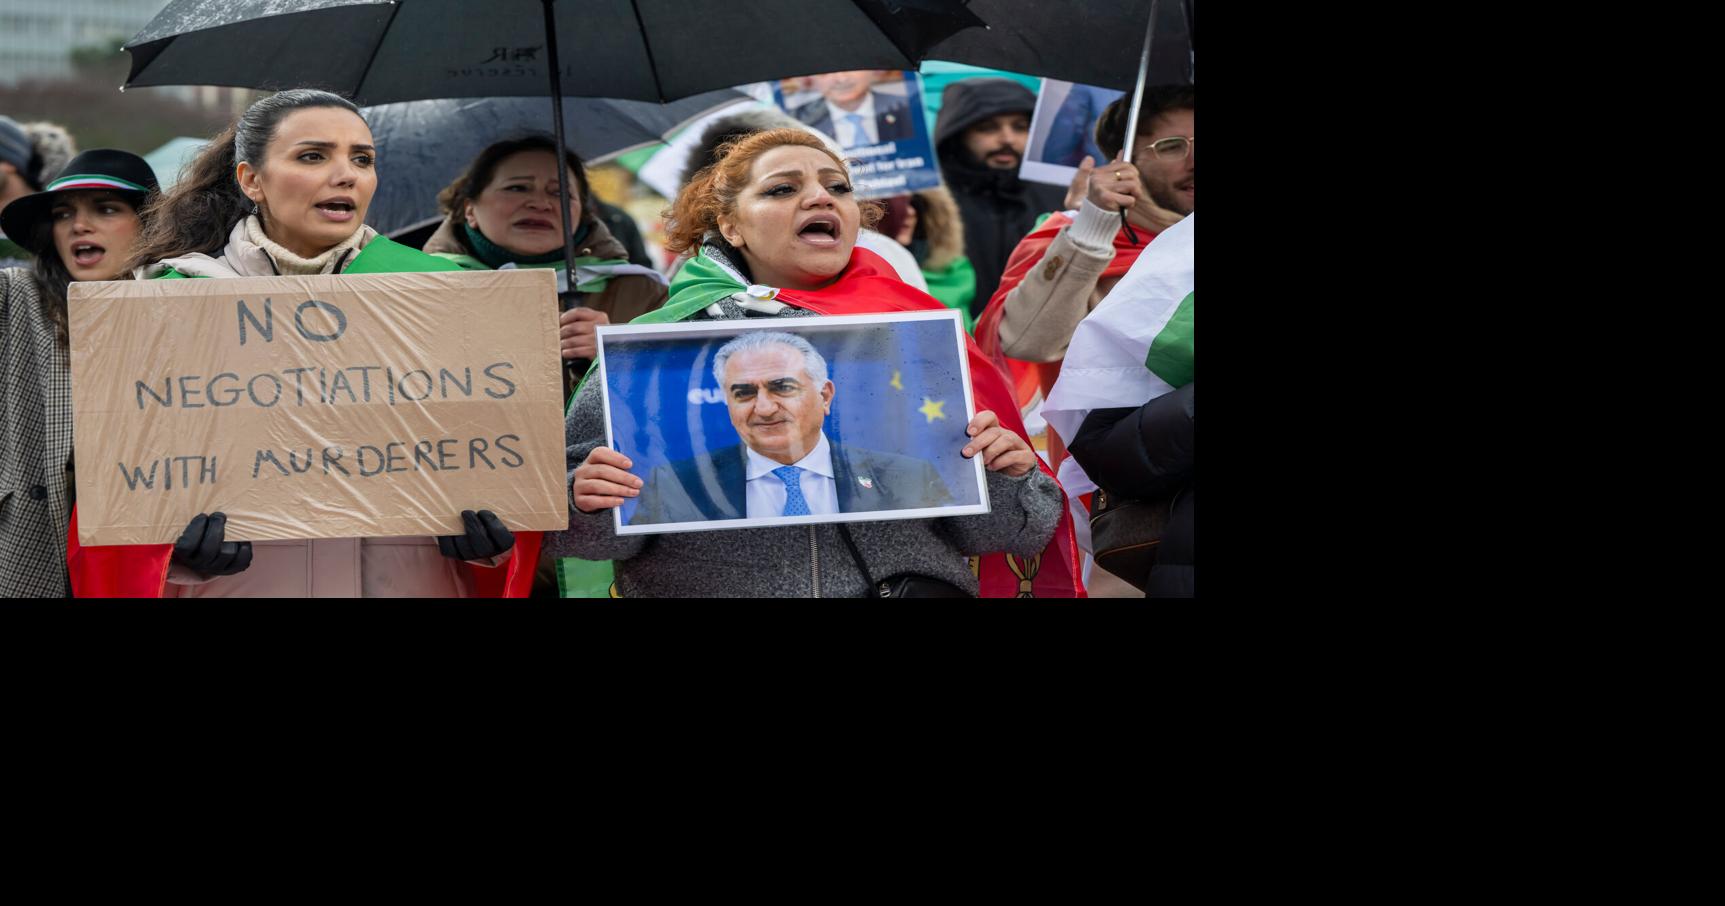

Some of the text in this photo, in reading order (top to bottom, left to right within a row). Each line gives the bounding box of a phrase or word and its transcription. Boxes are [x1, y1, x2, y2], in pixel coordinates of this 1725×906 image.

[237, 297, 348, 346] NO
[136, 362, 517, 410] NEGOTIATIONS
[118, 433, 525, 491] WITH MURDERERS
